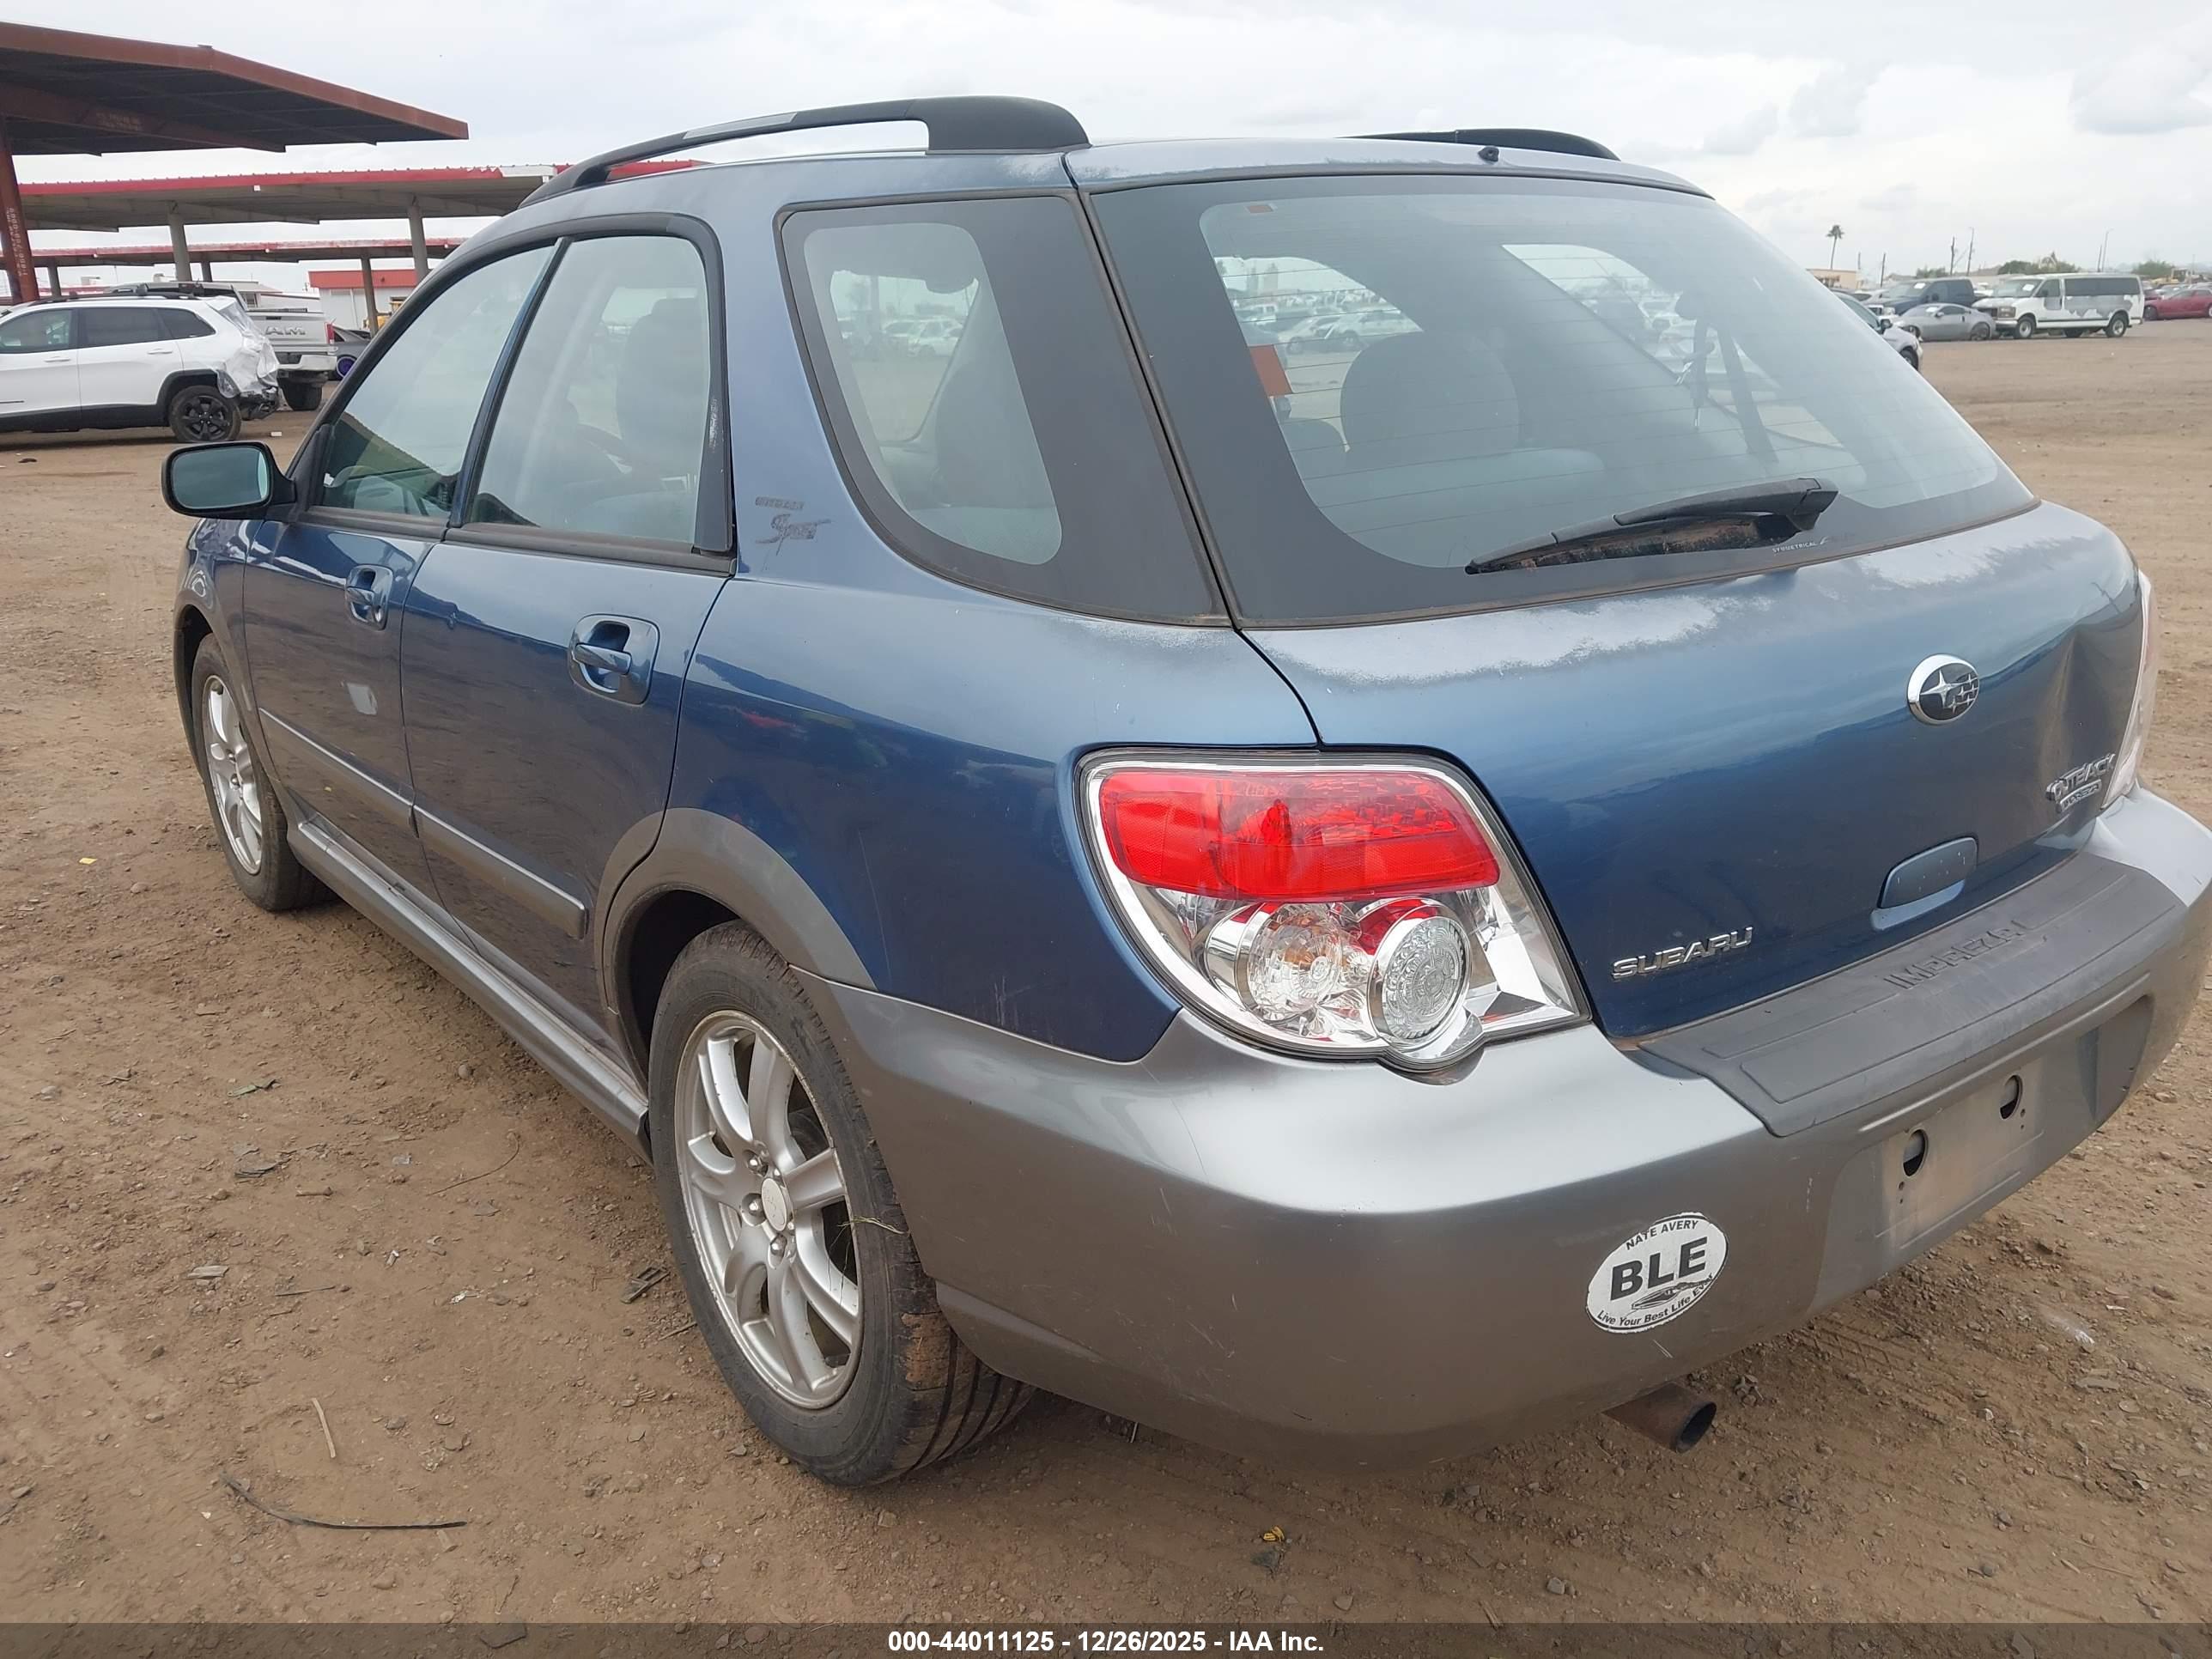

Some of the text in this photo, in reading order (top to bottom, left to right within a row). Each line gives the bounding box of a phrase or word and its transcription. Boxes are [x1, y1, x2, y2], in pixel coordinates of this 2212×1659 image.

[1611, 927, 1753, 980] SUBARU
[1626, 1219, 1698, 1251] NATE AVERY
[1610, 1236, 1708, 1301] BLE
[1596, 1310, 1616, 1325] Live
[1619, 1316, 1641, 1327] Your
[1644, 1308, 1668, 1323] Best
[1671, 1295, 1691, 1313] Life
